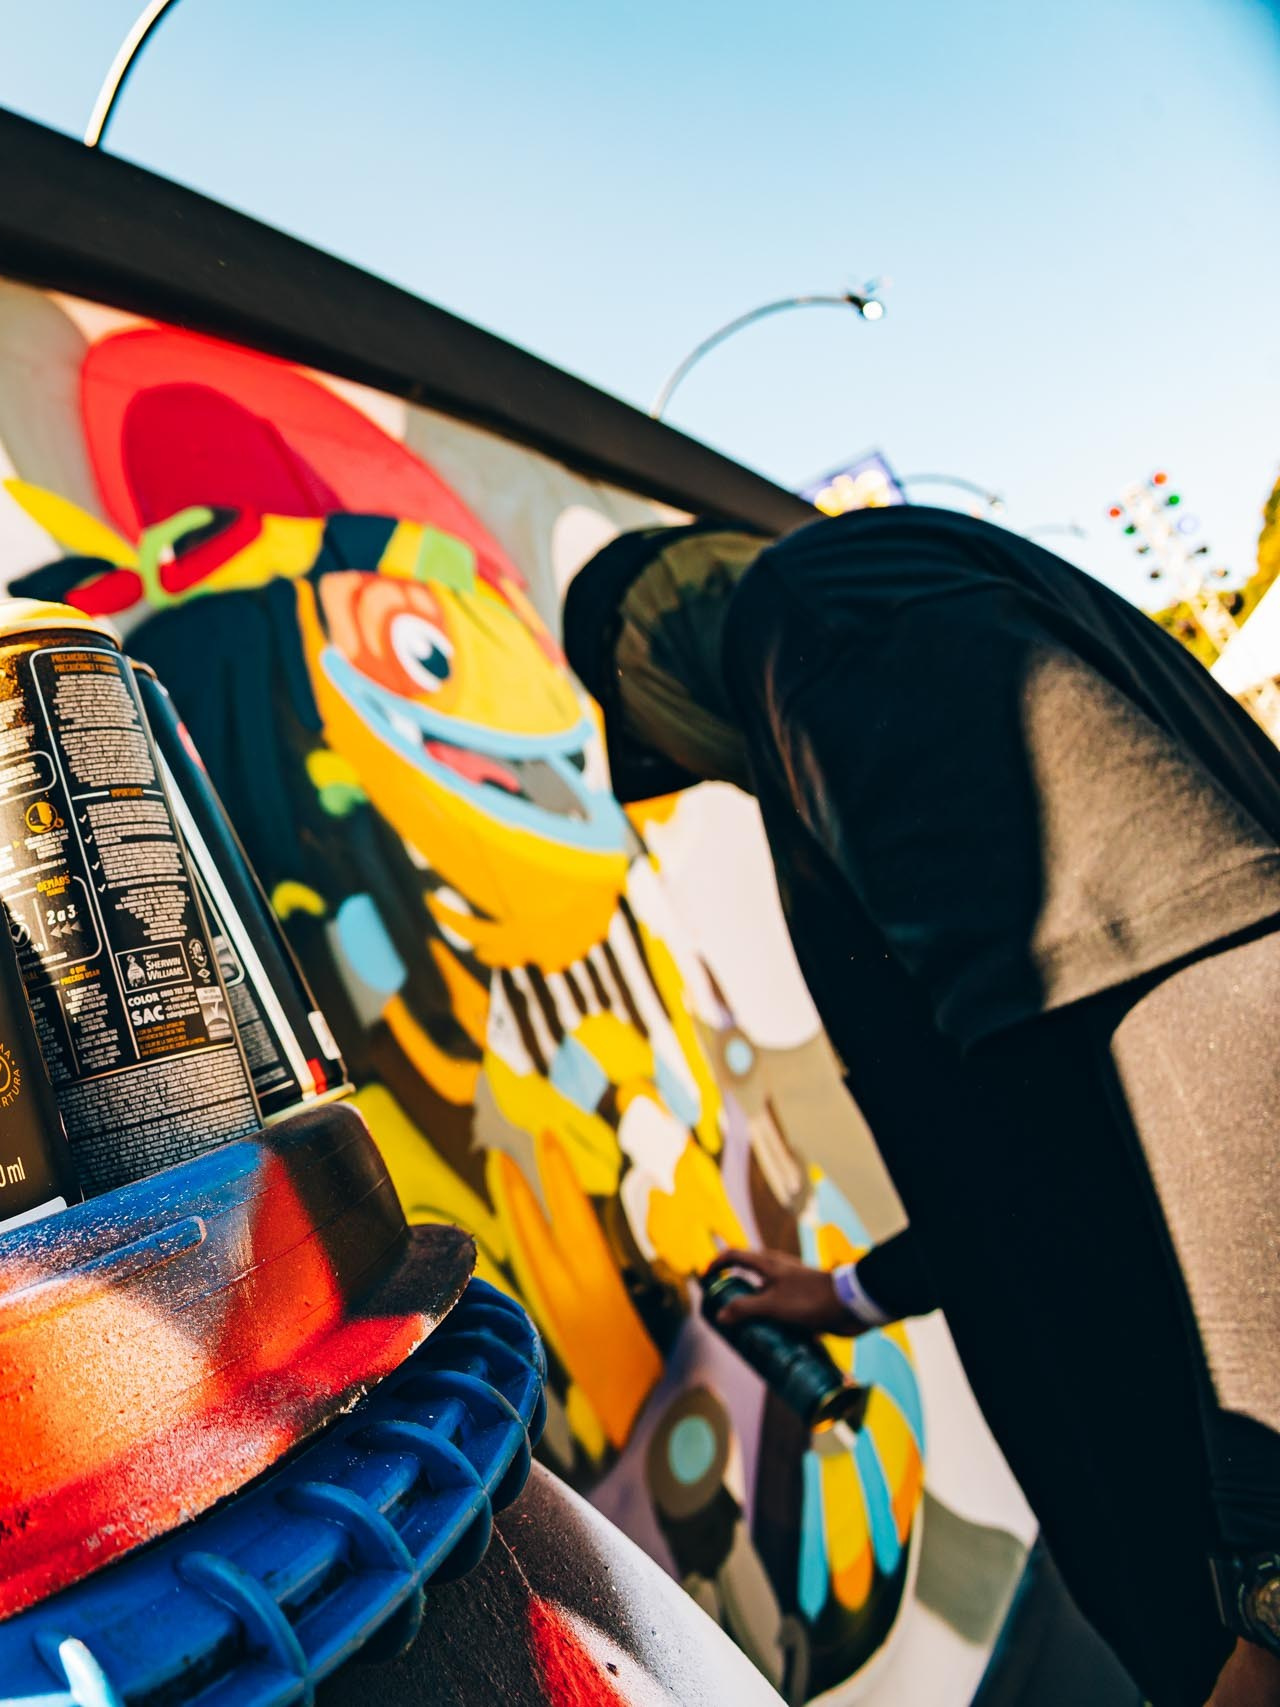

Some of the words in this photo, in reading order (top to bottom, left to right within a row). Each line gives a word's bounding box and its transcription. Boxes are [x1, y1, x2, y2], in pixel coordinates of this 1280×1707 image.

[46, 910, 56, 925] 2
[67, 904, 76, 919] 3
[127, 992, 160, 1007] COLOR
[131, 1005, 165, 1026] SAC
[9, 1157, 26, 1185] ml
